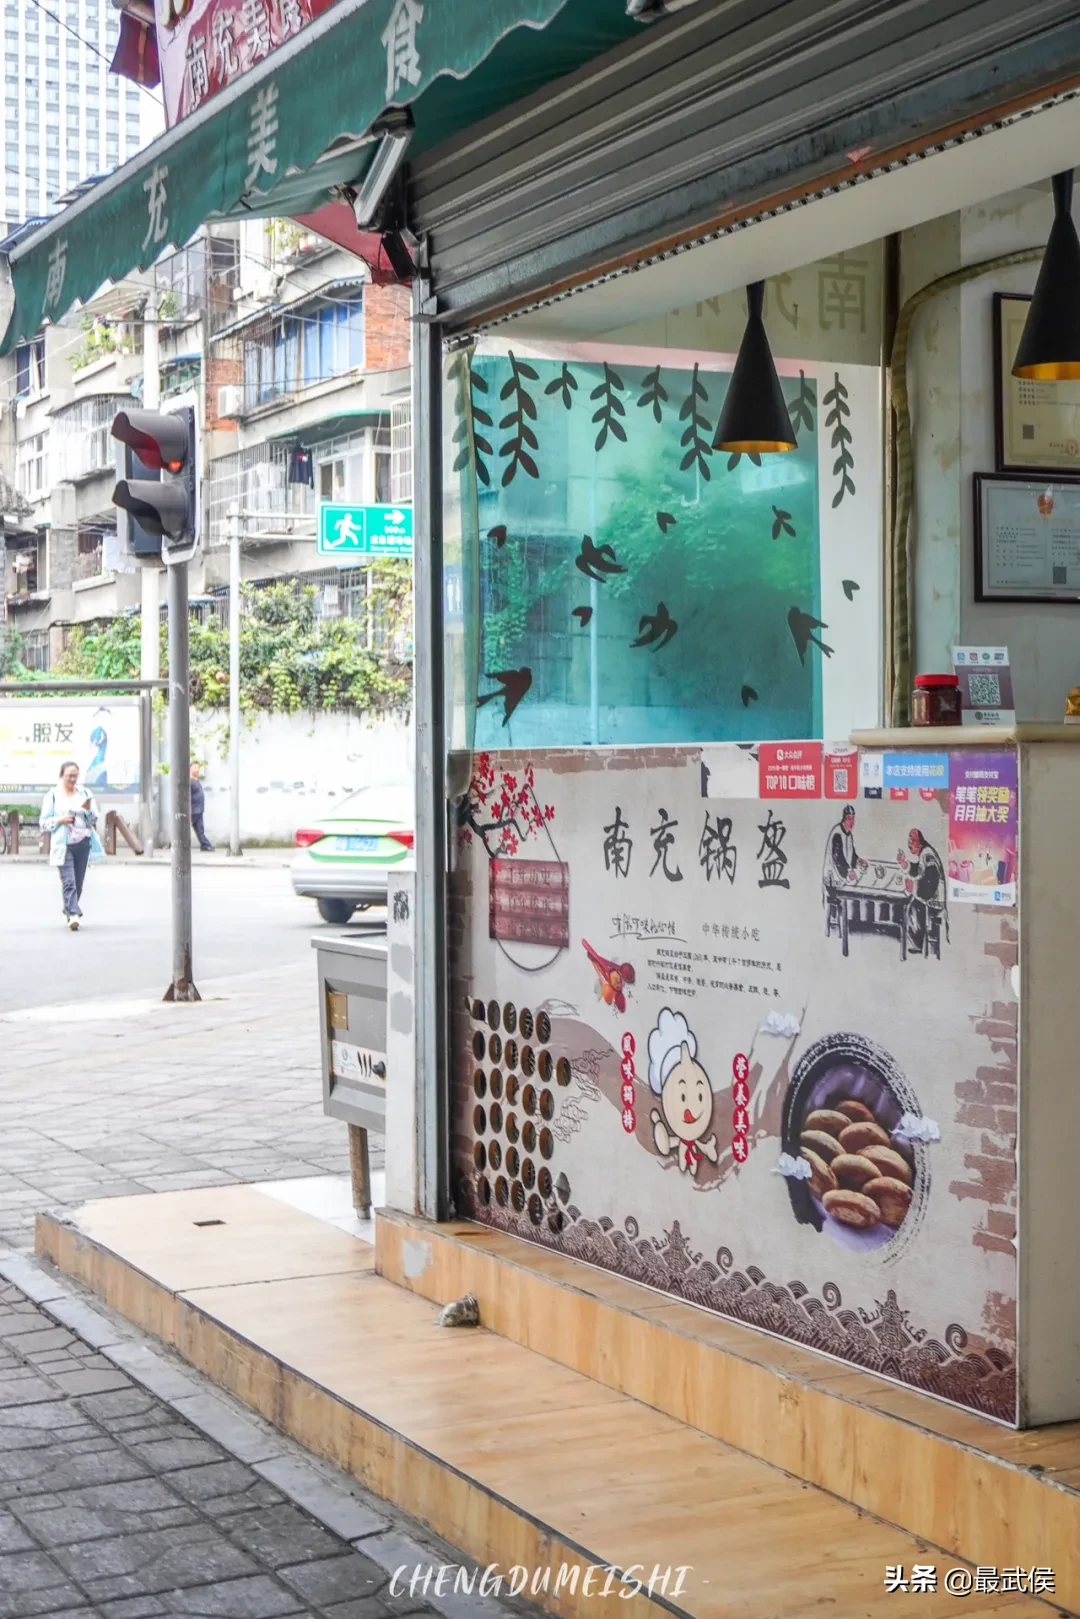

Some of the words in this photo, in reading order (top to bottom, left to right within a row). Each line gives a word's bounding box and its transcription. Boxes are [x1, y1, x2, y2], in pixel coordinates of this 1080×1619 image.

[42, 0, 425, 313] 南充美食
[33, 722, 73, 743] 脱发
[603, 805, 790, 890] 南充锅盔
[702, 922, 761, 943] 中华传统小吃
